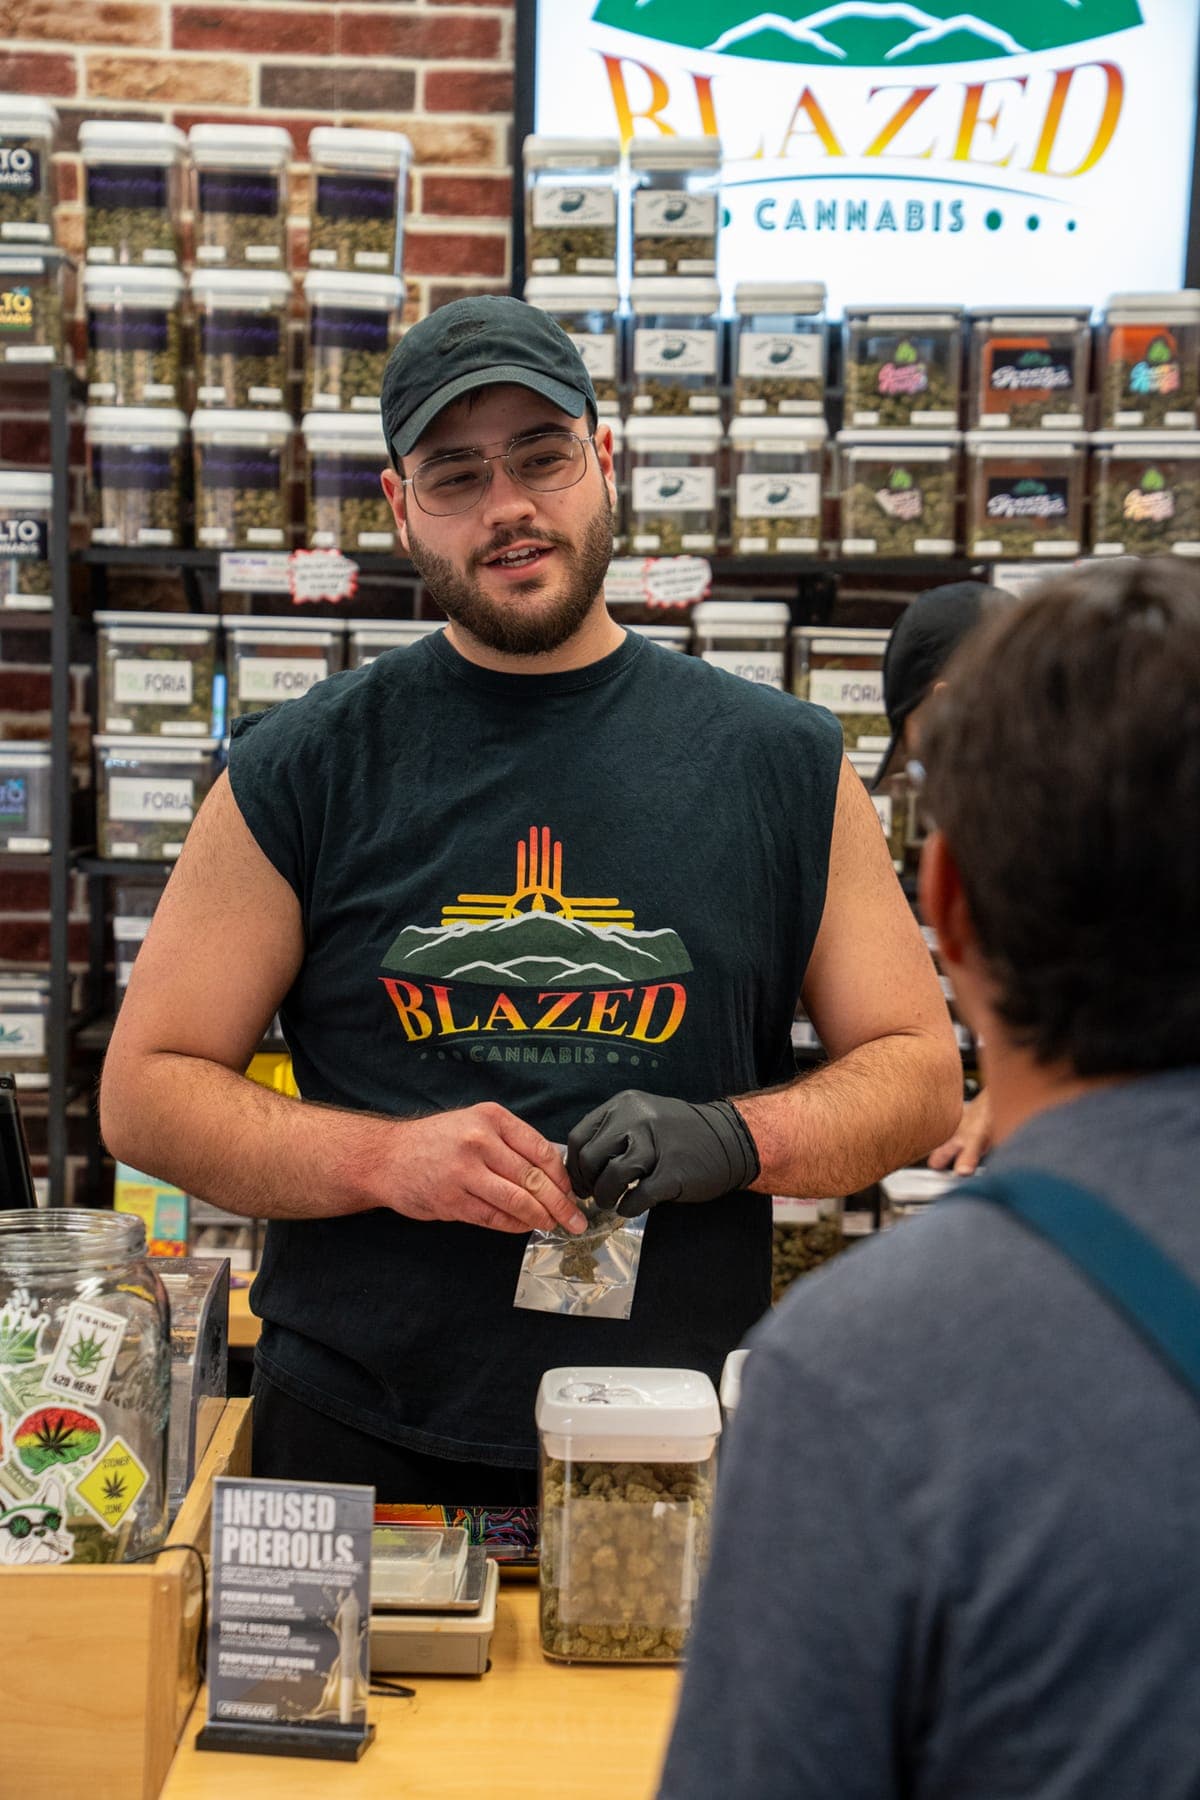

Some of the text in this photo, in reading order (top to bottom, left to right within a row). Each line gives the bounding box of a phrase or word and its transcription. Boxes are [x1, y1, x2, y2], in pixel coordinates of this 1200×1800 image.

[591, 49, 1125, 179] BLAZED
[755, 198, 966, 232] CANNABIS
[0, 292, 33, 312] TO
[378, 976, 687, 1044] BLAZED
[469, 1045, 597, 1065] CANNABIS
[222, 1488, 336, 1532] INFUSED
[221, 1526, 354, 1570] PREROLLS
